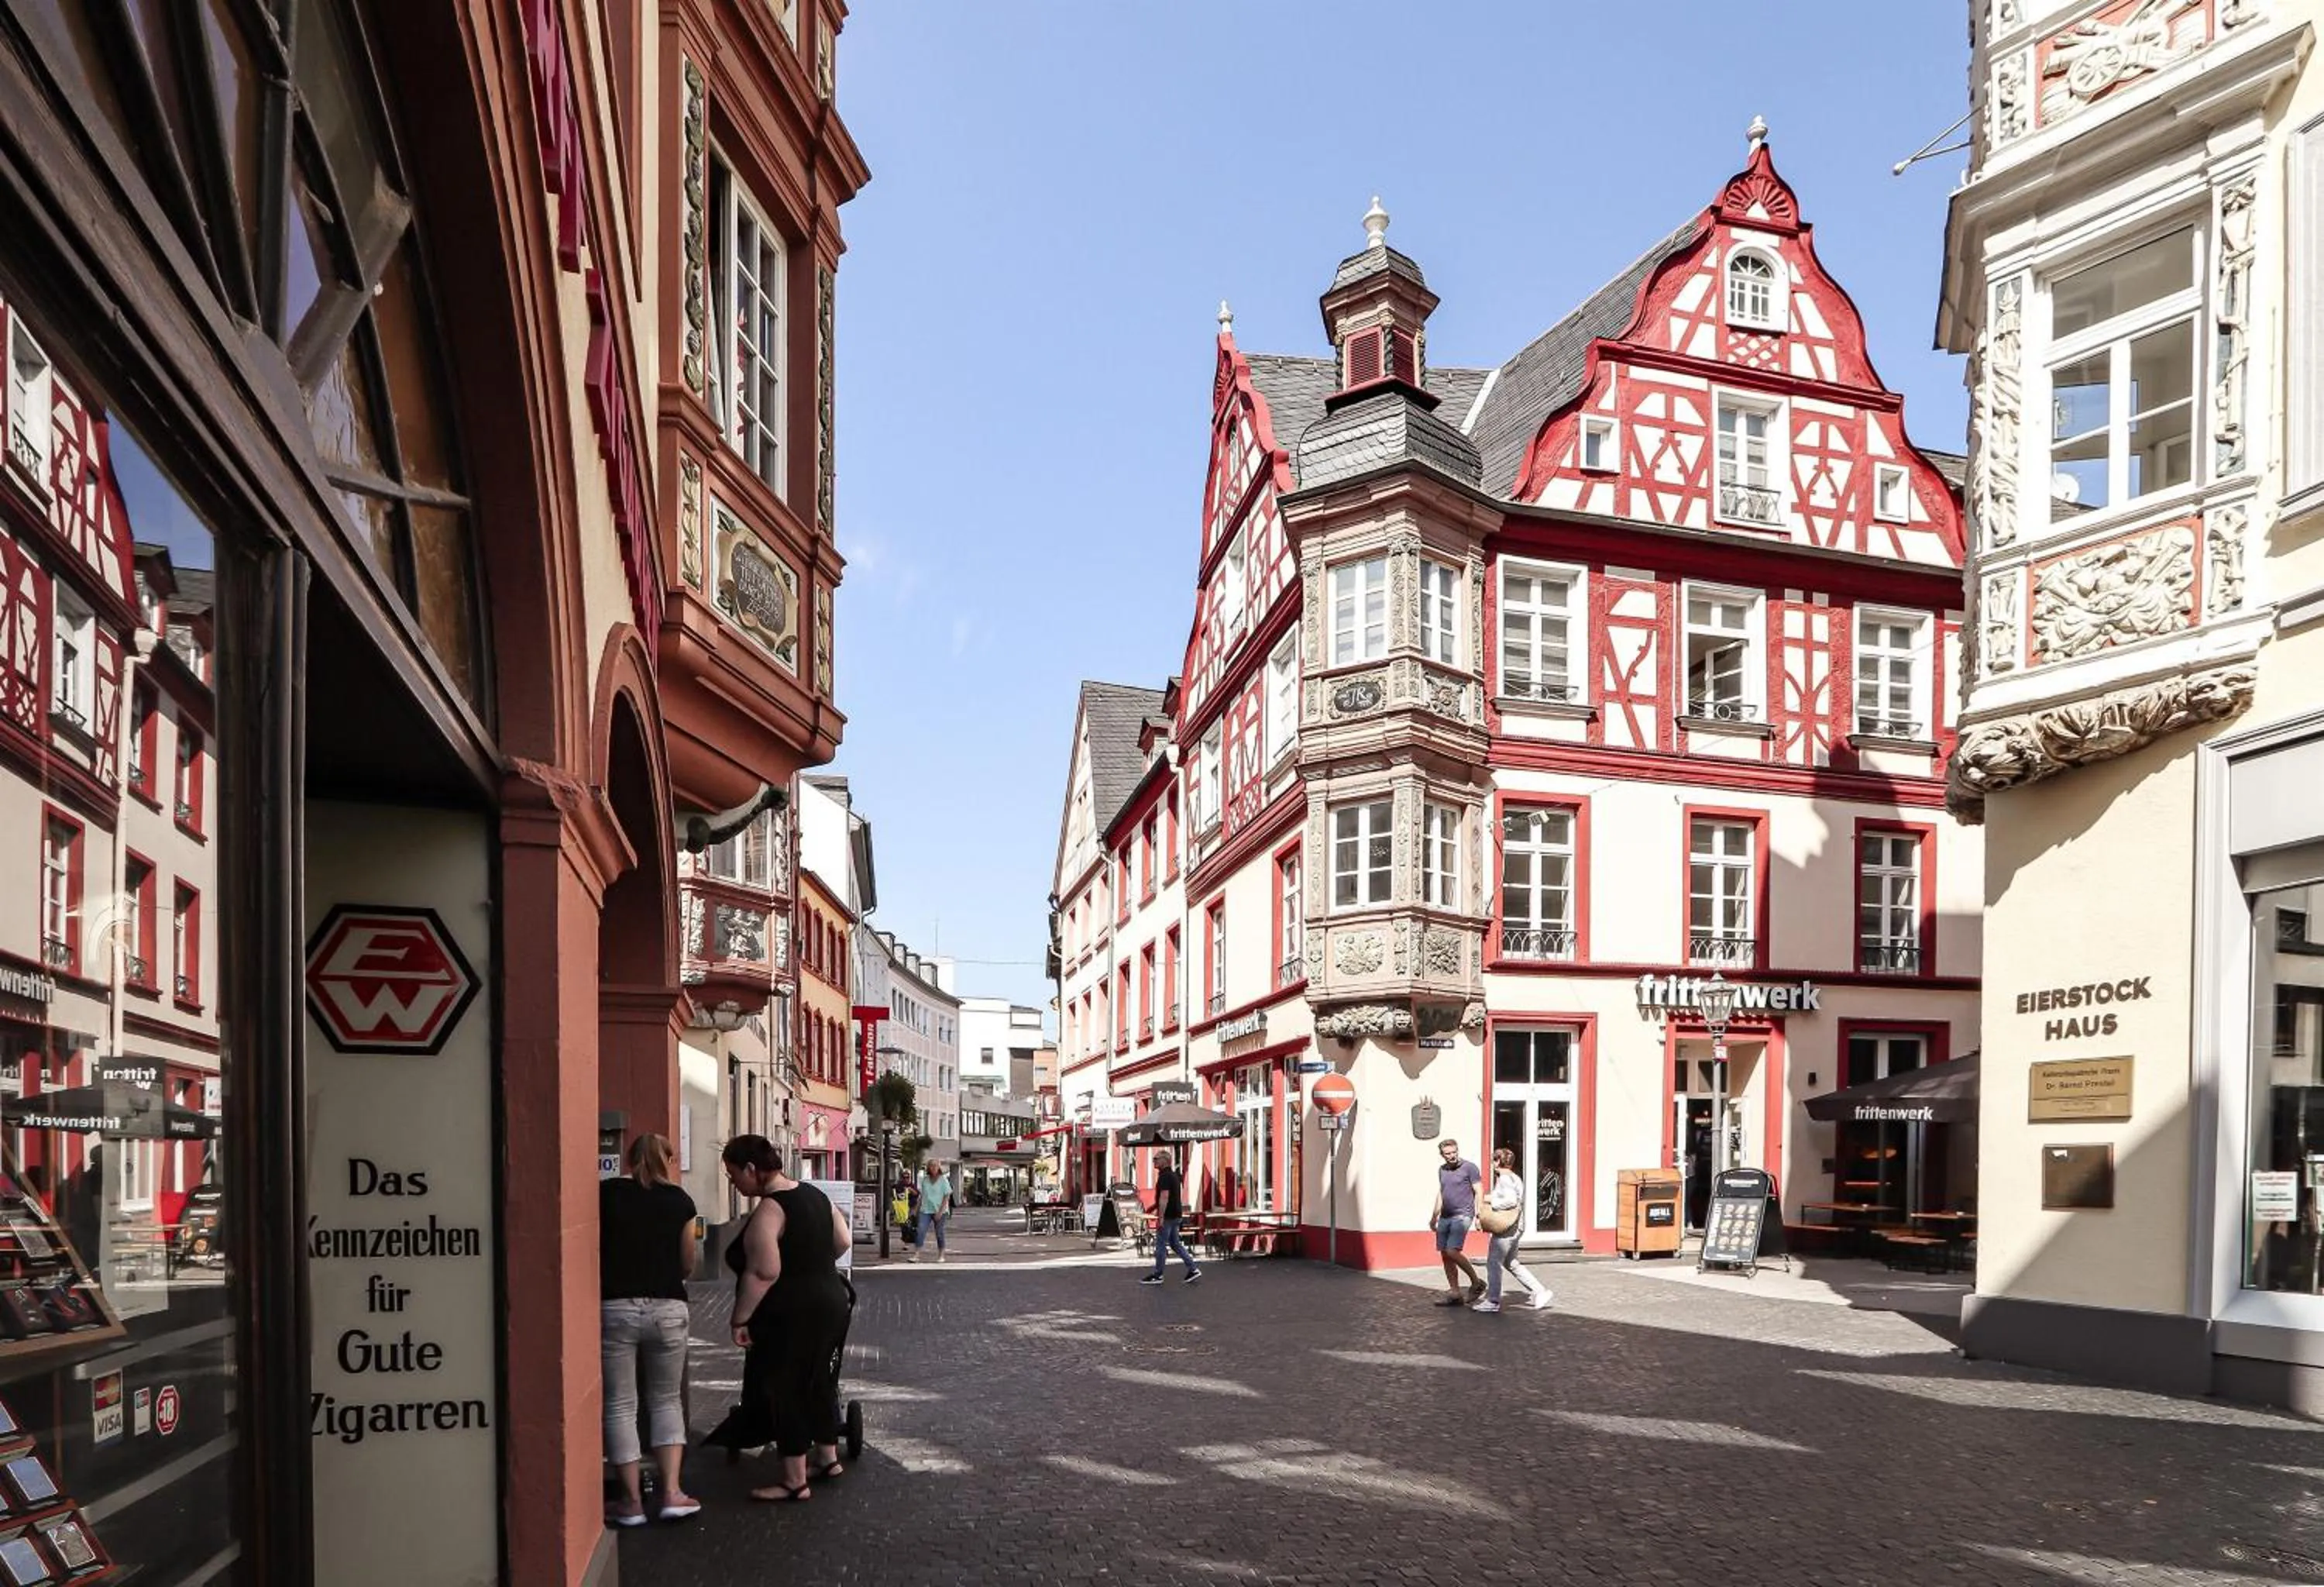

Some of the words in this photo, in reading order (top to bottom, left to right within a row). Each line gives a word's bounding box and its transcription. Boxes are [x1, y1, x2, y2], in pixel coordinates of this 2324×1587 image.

[1639, 974, 1820, 1010] frittwerk
[2016, 976, 2152, 1014] EIERSTOCK
[2044, 1013, 2119, 1041] HAUS
[1855, 1106, 1934, 1121] frittenwerk
[1170, 1128, 1231, 1139] frittenwerk
[348, 1158, 428, 1196] Das
[365, 1274, 411, 1313] für
[337, 1329, 443, 1374] Gute
[97, 1413, 122, 1436] VISA
